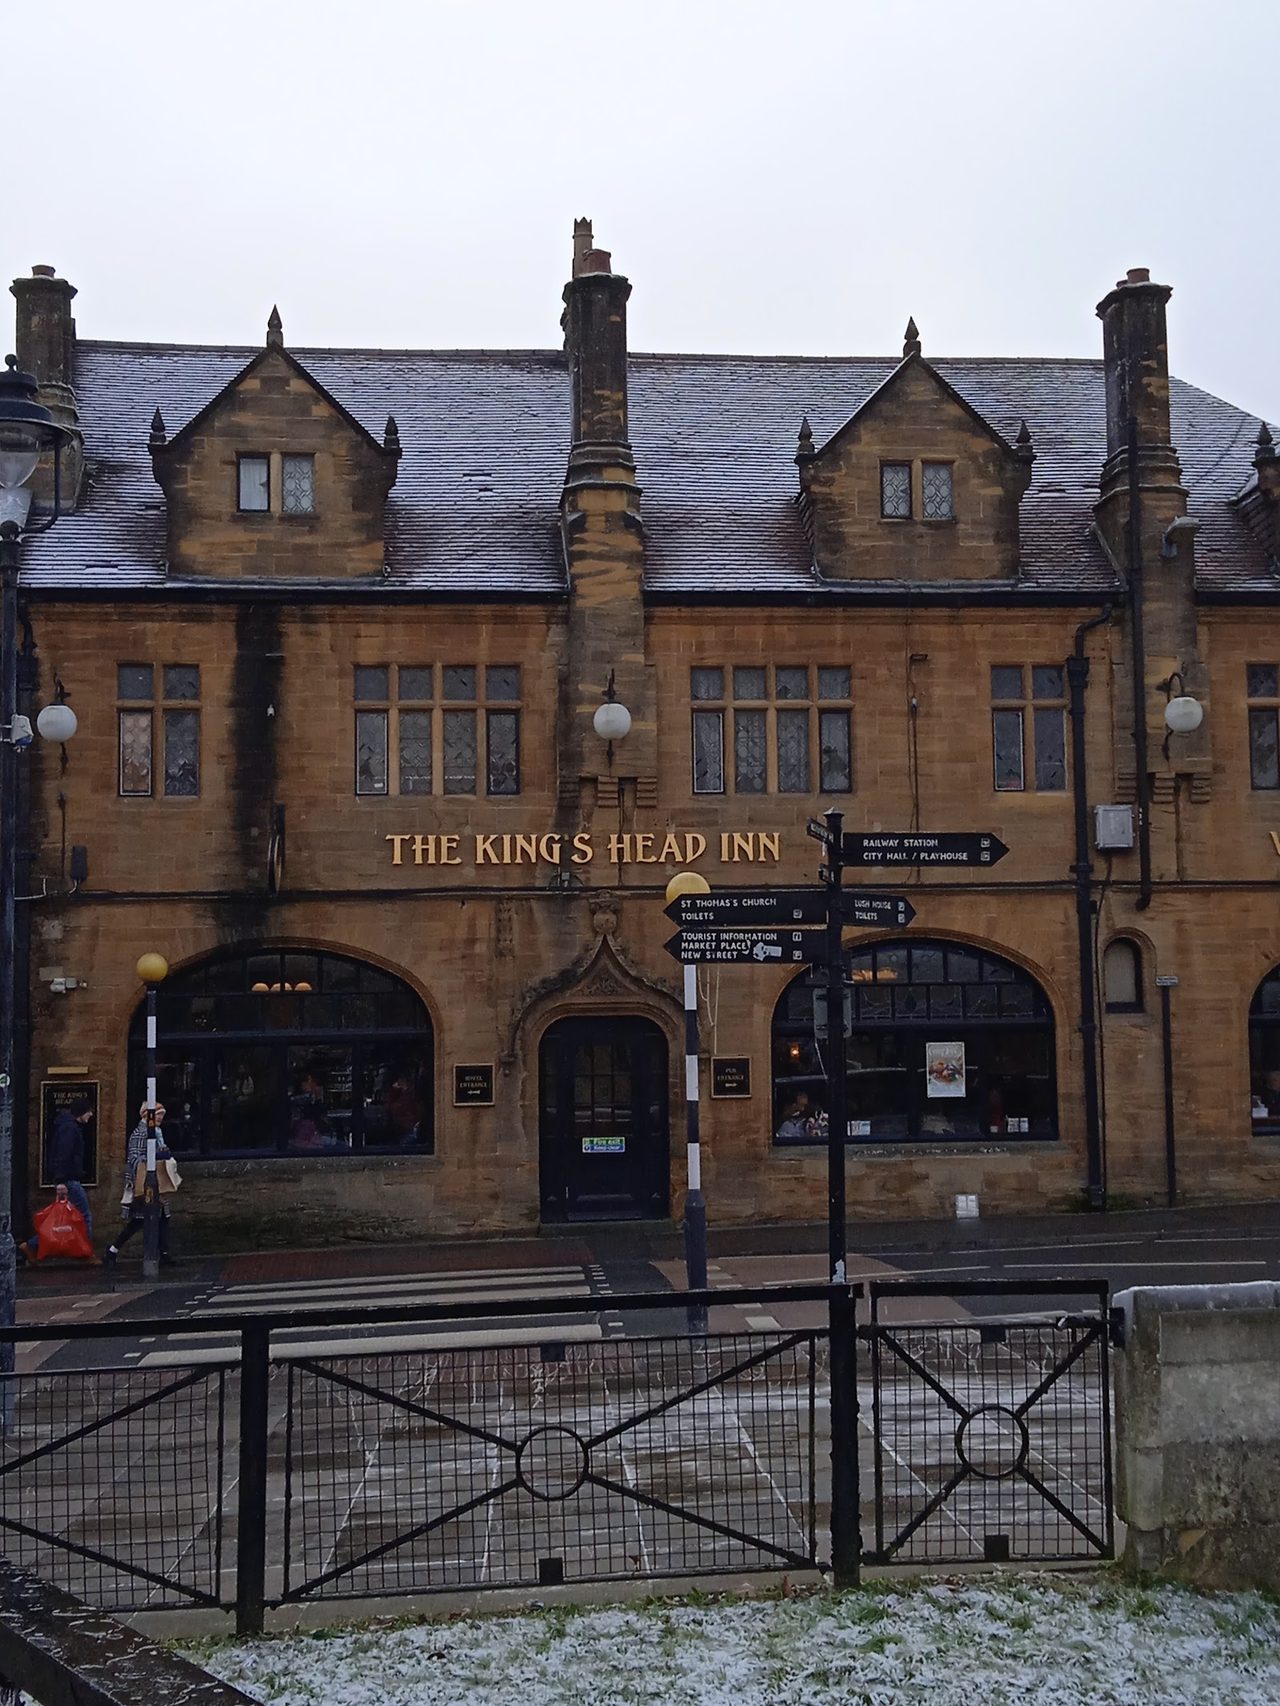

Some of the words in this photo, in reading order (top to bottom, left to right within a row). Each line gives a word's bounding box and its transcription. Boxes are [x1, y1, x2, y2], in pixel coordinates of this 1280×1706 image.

[863, 839, 899, 847] RAILWAY
[904, 839, 939, 847] STATION
[385, 833, 463, 866] THE
[474, 832, 593, 866] KING'S
[608, 832, 707, 865] HEAD
[720, 832, 781, 864] INN
[863, 852, 883, 860] CITY
[887, 852, 908, 860] HALL
[920, 852, 968, 860] PLAYHOUSE
[681, 900, 691, 908] ST
[696, 899, 738, 907] THOMAS'S
[742, 898, 777, 906] CHURCH
[872, 900, 891, 910] HOUSE
[682, 912, 714, 920] TOILETS
[855, 911, 878, 920] TOILETS
[682, 932, 717, 940] TOURIST
[720, 932, 778, 940] INFORMATION
[681, 942, 716, 950] MARKET
[721, 942, 747, 950] PLACE
[681, 951, 701, 959] NEW
[706, 951, 738, 959] STREET
